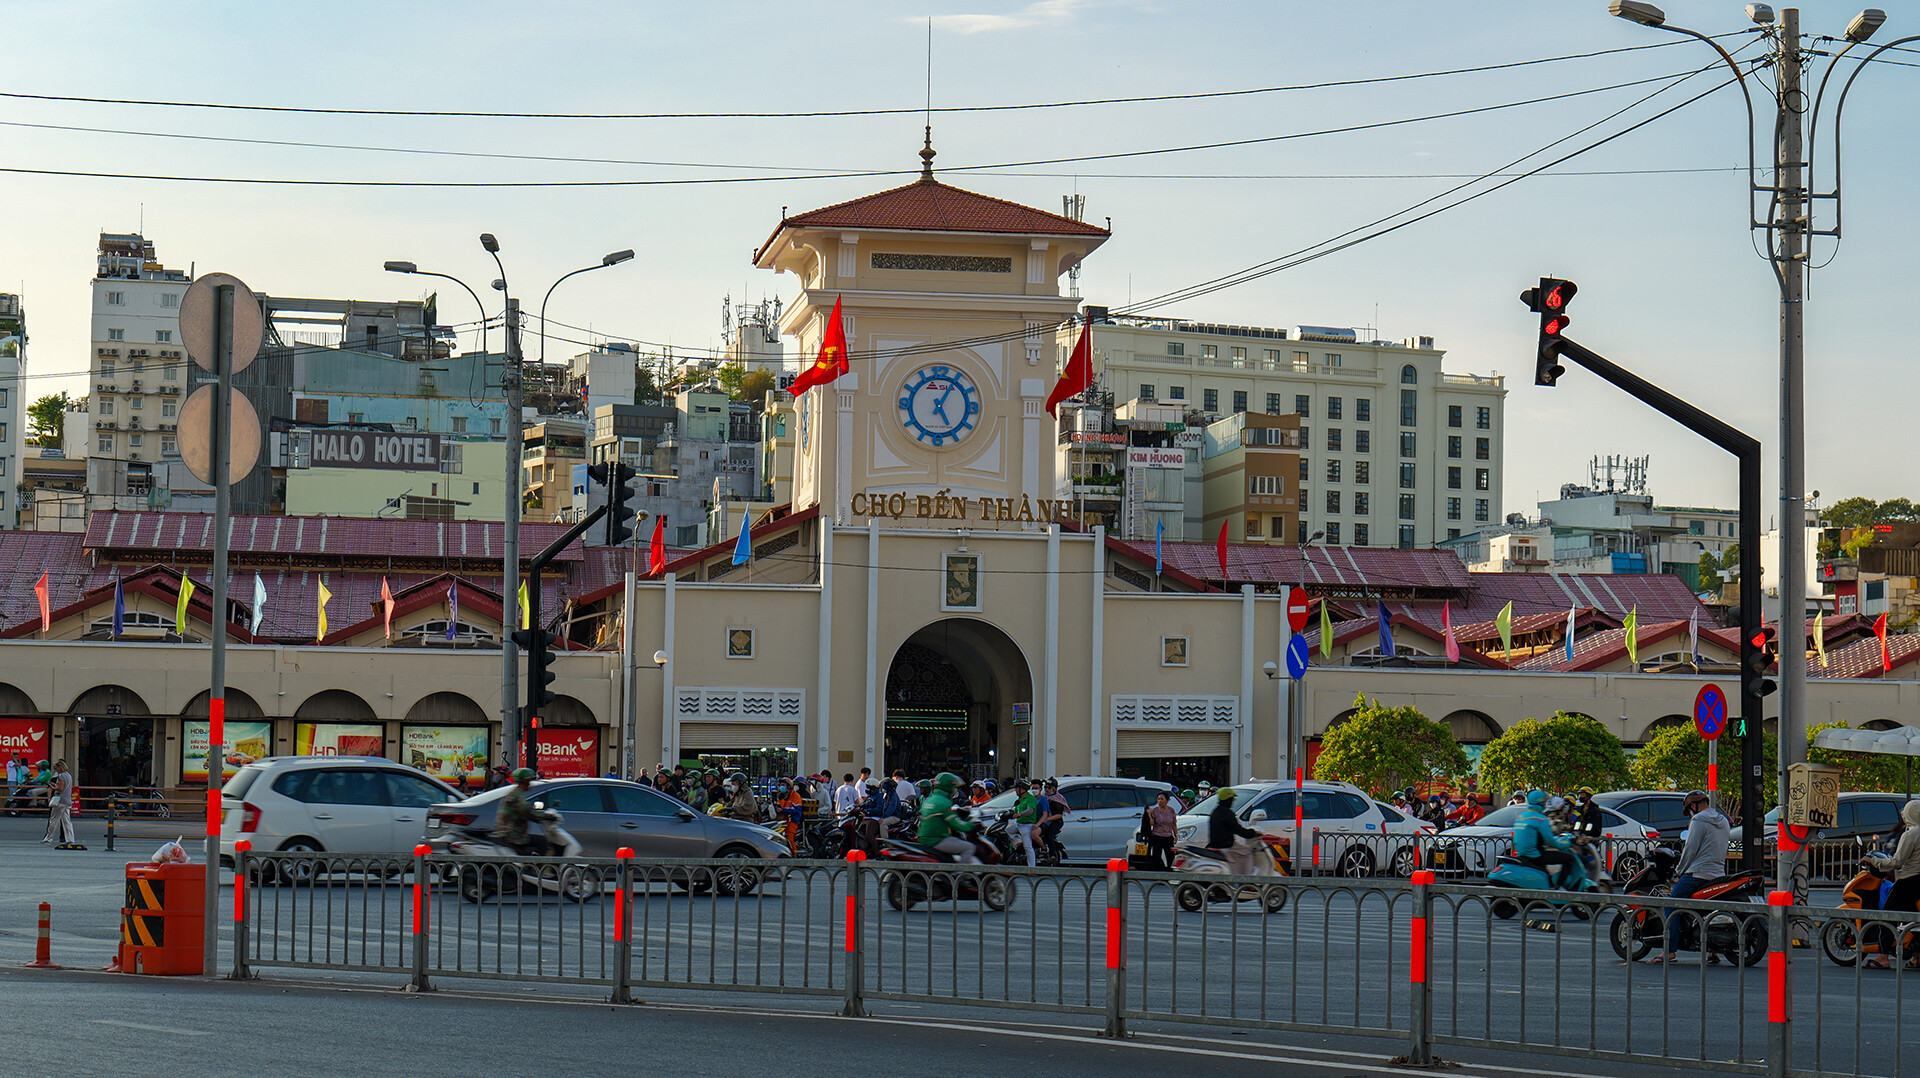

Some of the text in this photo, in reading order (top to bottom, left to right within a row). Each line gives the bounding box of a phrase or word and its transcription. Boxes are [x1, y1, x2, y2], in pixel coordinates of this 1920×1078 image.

[932, 366, 949, 378] 12
[899, 398, 911, 410] 9
[968, 402, 979, 414] 3
[932, 434, 943, 446] 6
[313, 434, 436, 464] HALO HOTEL
[1130, 453, 1147, 462] KIM
[851, 488, 1074, 522] CHỢ BẾN THÀNH
[0, 734, 29, 747] ank
